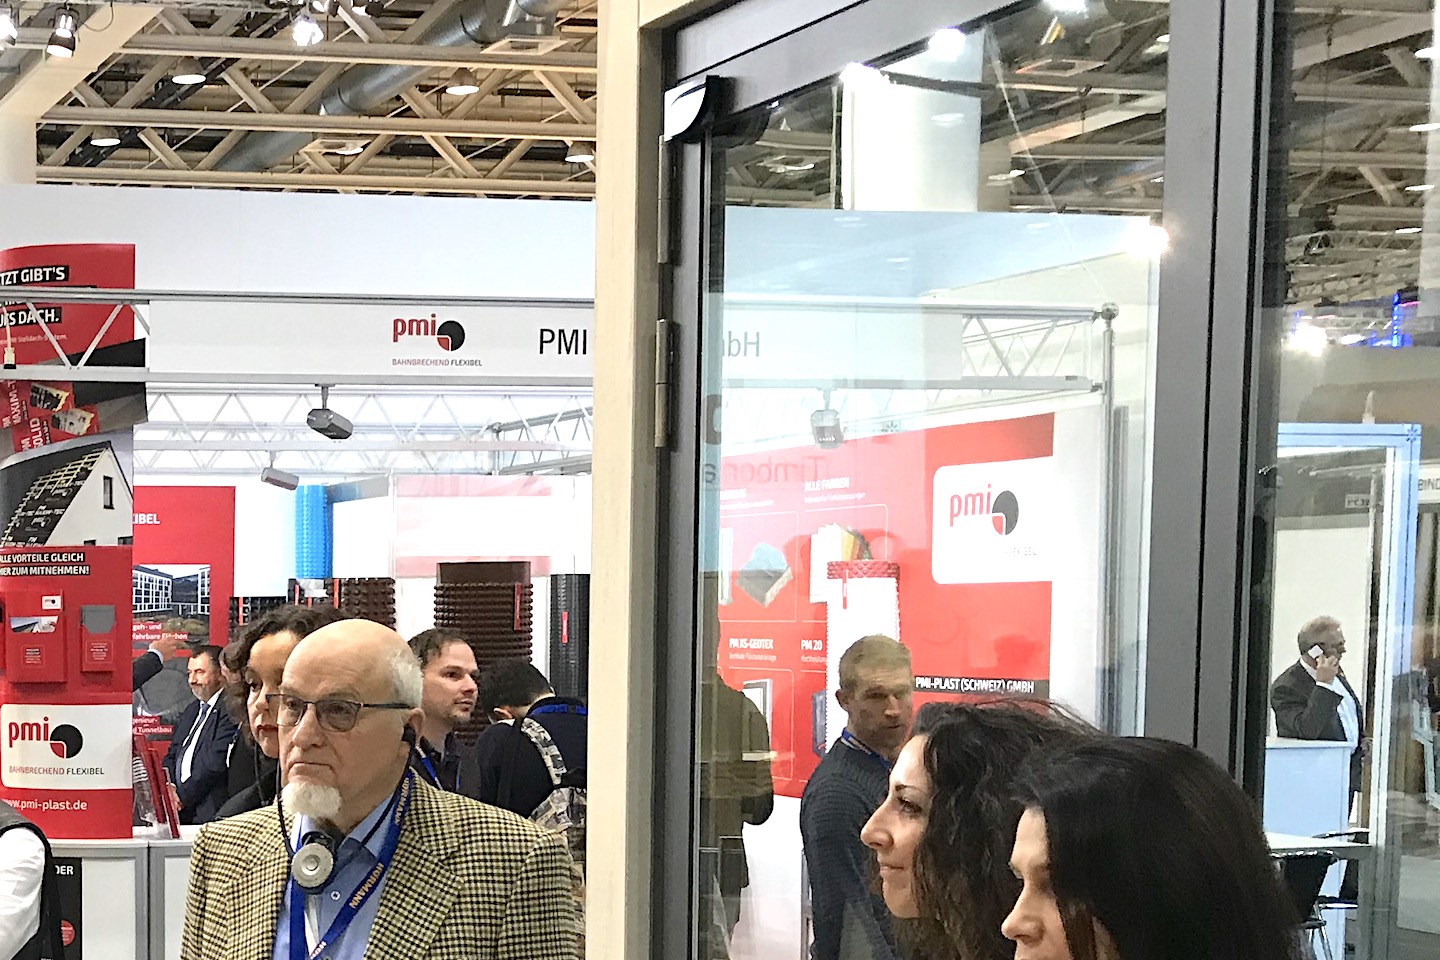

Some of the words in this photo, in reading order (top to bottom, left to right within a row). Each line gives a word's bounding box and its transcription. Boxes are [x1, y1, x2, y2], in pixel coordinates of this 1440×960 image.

[20, 266, 66, 283] GIBT'S
[392, 313, 437, 343] pmi
[539, 328, 588, 355] PMI
[392, 358, 450, 367] BAHNBRECHEND
[451, 359, 483, 367] FLEXIBEL
[949, 483, 992, 527] pmi
[12, 553, 50, 563] VORTEILE
[50, 552, 84, 562] GLEICH
[11, 566, 29, 576] ZUM
[29, 565, 90, 575] MITNEHMEN!
[915, 676, 960, 690] PMI-PLAST
[8, 716, 49, 748] pmi
[9, 765, 65, 776] BAHNBRECHEND
[66, 767, 105, 776] FLEXIBEL
